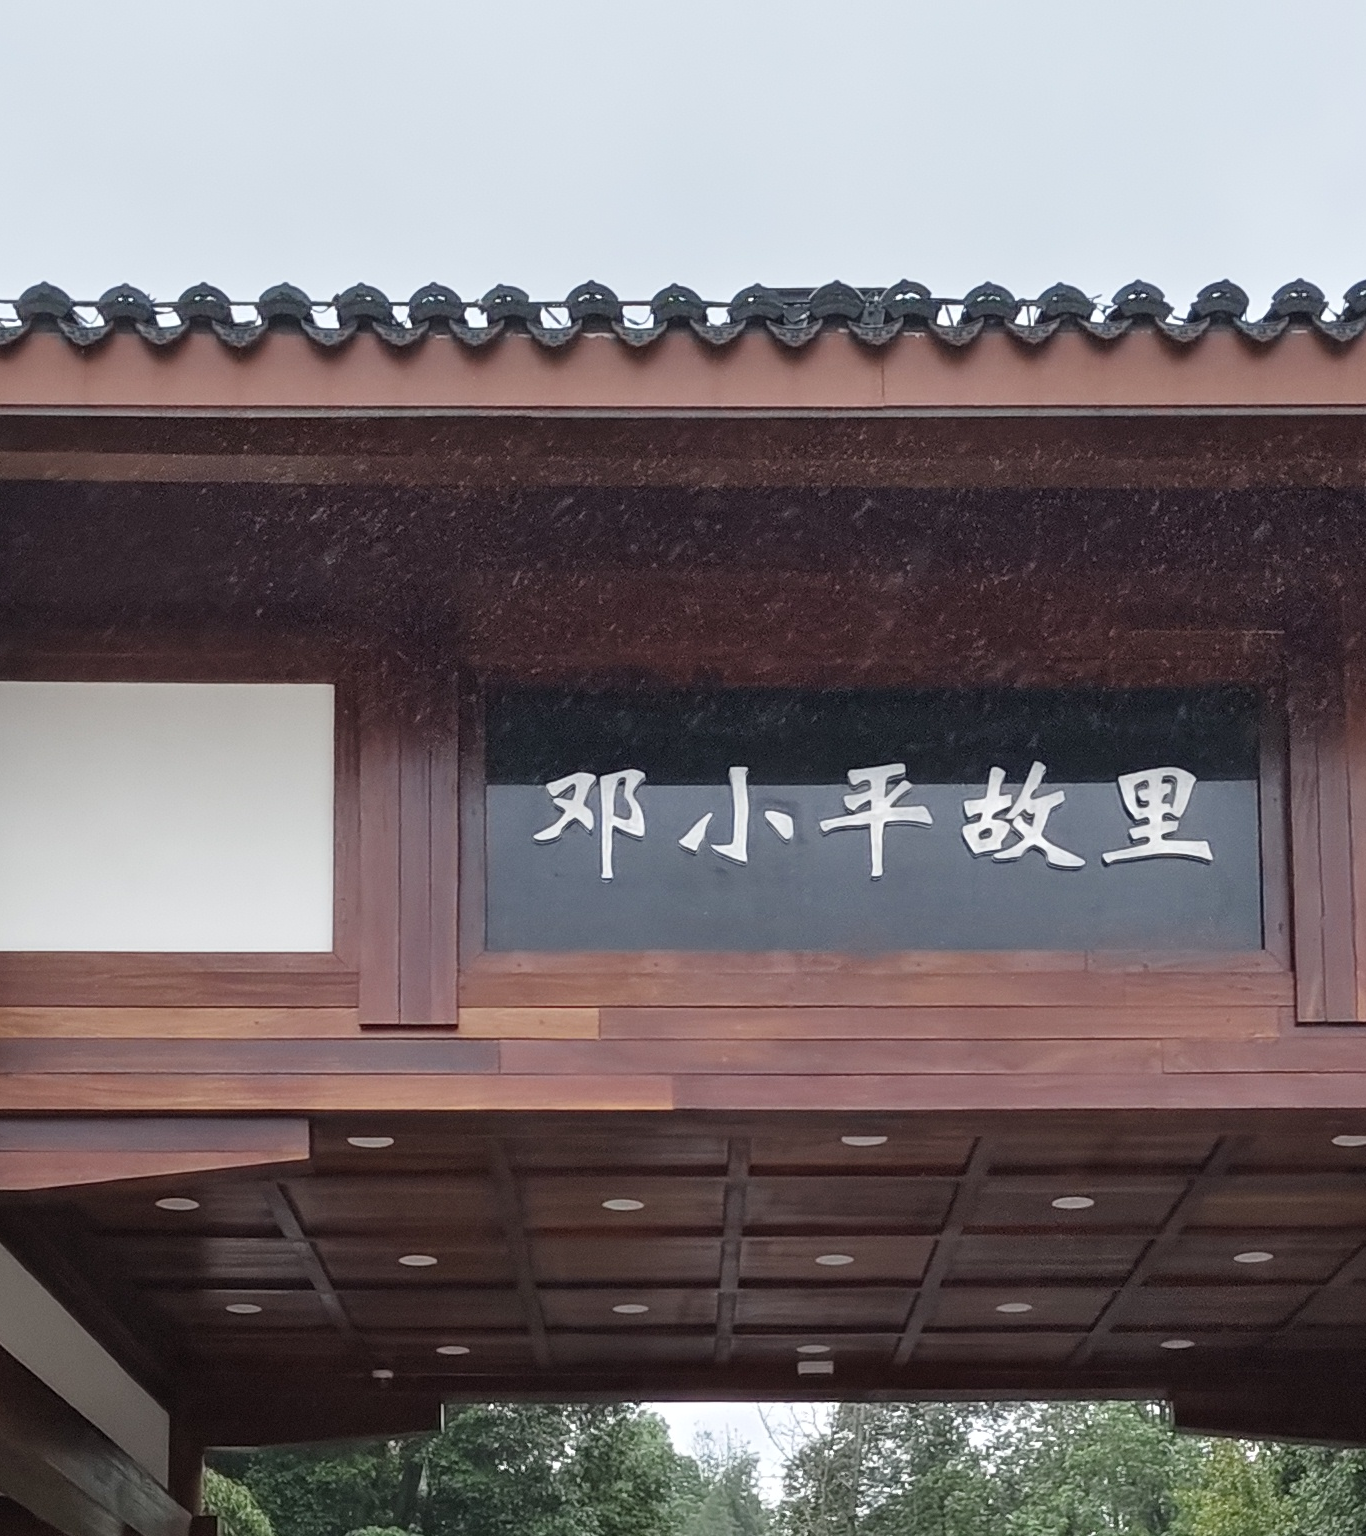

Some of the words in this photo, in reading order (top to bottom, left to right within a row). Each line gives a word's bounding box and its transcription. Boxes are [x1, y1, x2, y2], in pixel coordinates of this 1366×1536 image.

[532, 761, 1214, 881] 邓小平故里
